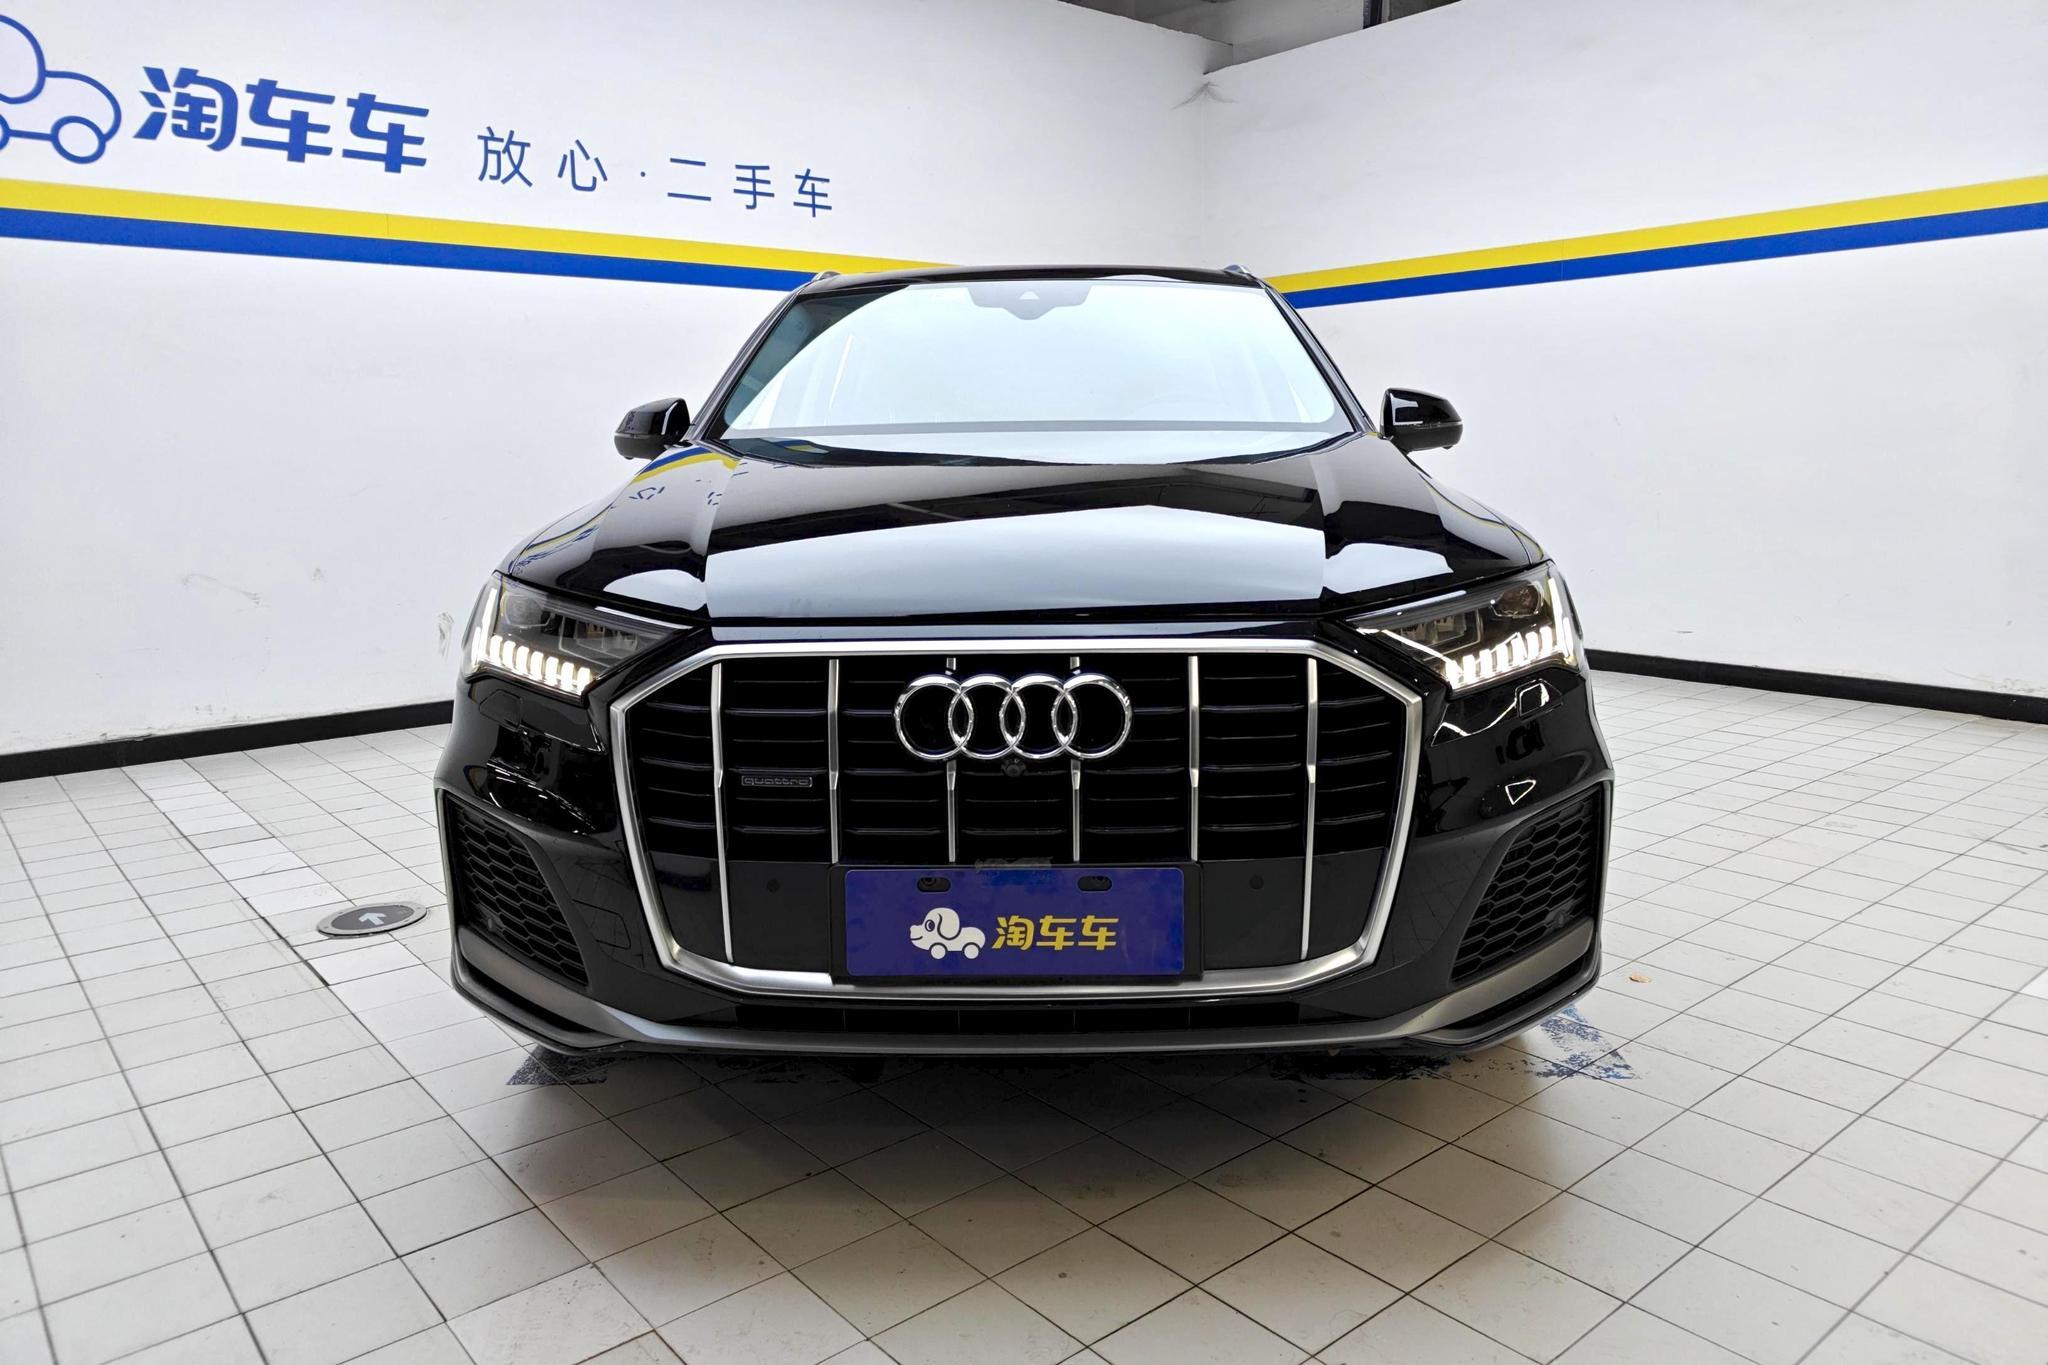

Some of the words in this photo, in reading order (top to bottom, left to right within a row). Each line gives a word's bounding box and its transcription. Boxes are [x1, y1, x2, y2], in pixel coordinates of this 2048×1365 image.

[135, 67, 429, 173] 淘车车
[744, 777, 809, 786] quattro
[992, 914, 1119, 951] 淘车车
